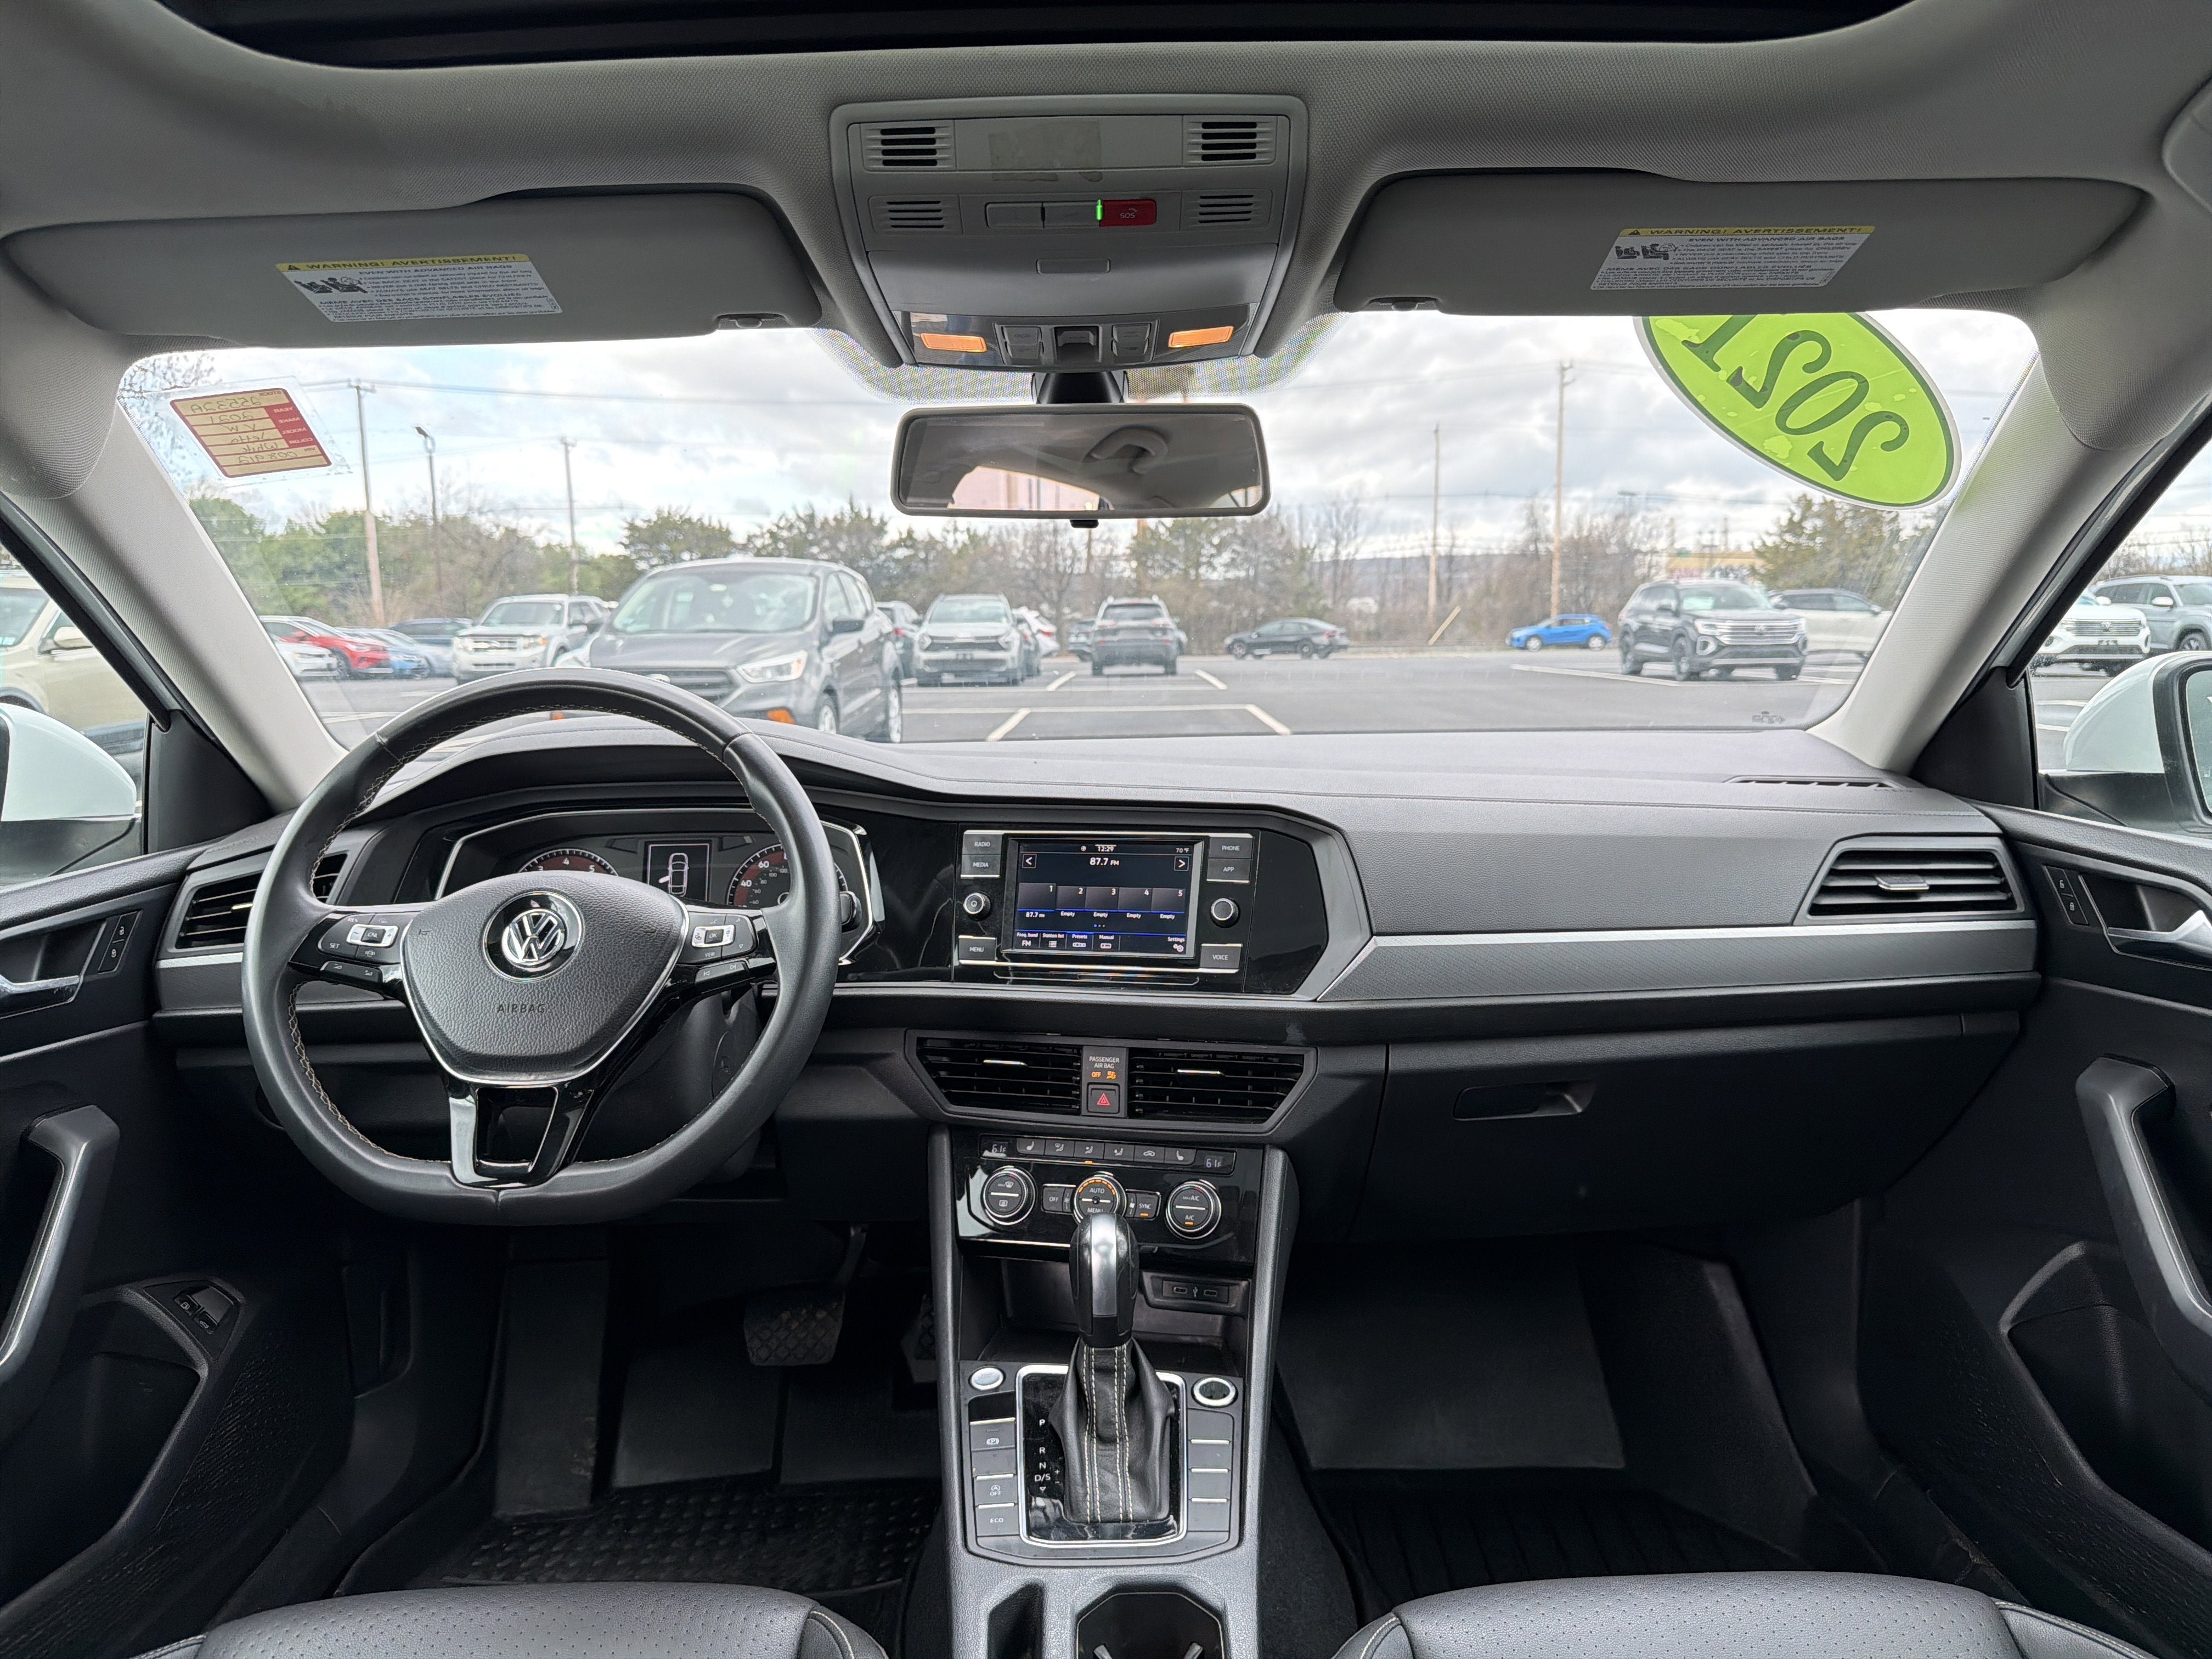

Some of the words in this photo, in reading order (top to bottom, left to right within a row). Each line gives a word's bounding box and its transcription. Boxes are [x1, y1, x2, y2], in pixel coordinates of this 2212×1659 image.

[392, 256, 516, 266] AVERTISSEMENT!
[1090, 857, 1109, 866] 87.7
[497, 1003, 546, 1014] AIRBAG
[1034, 1474, 1051, 1482] D/S
